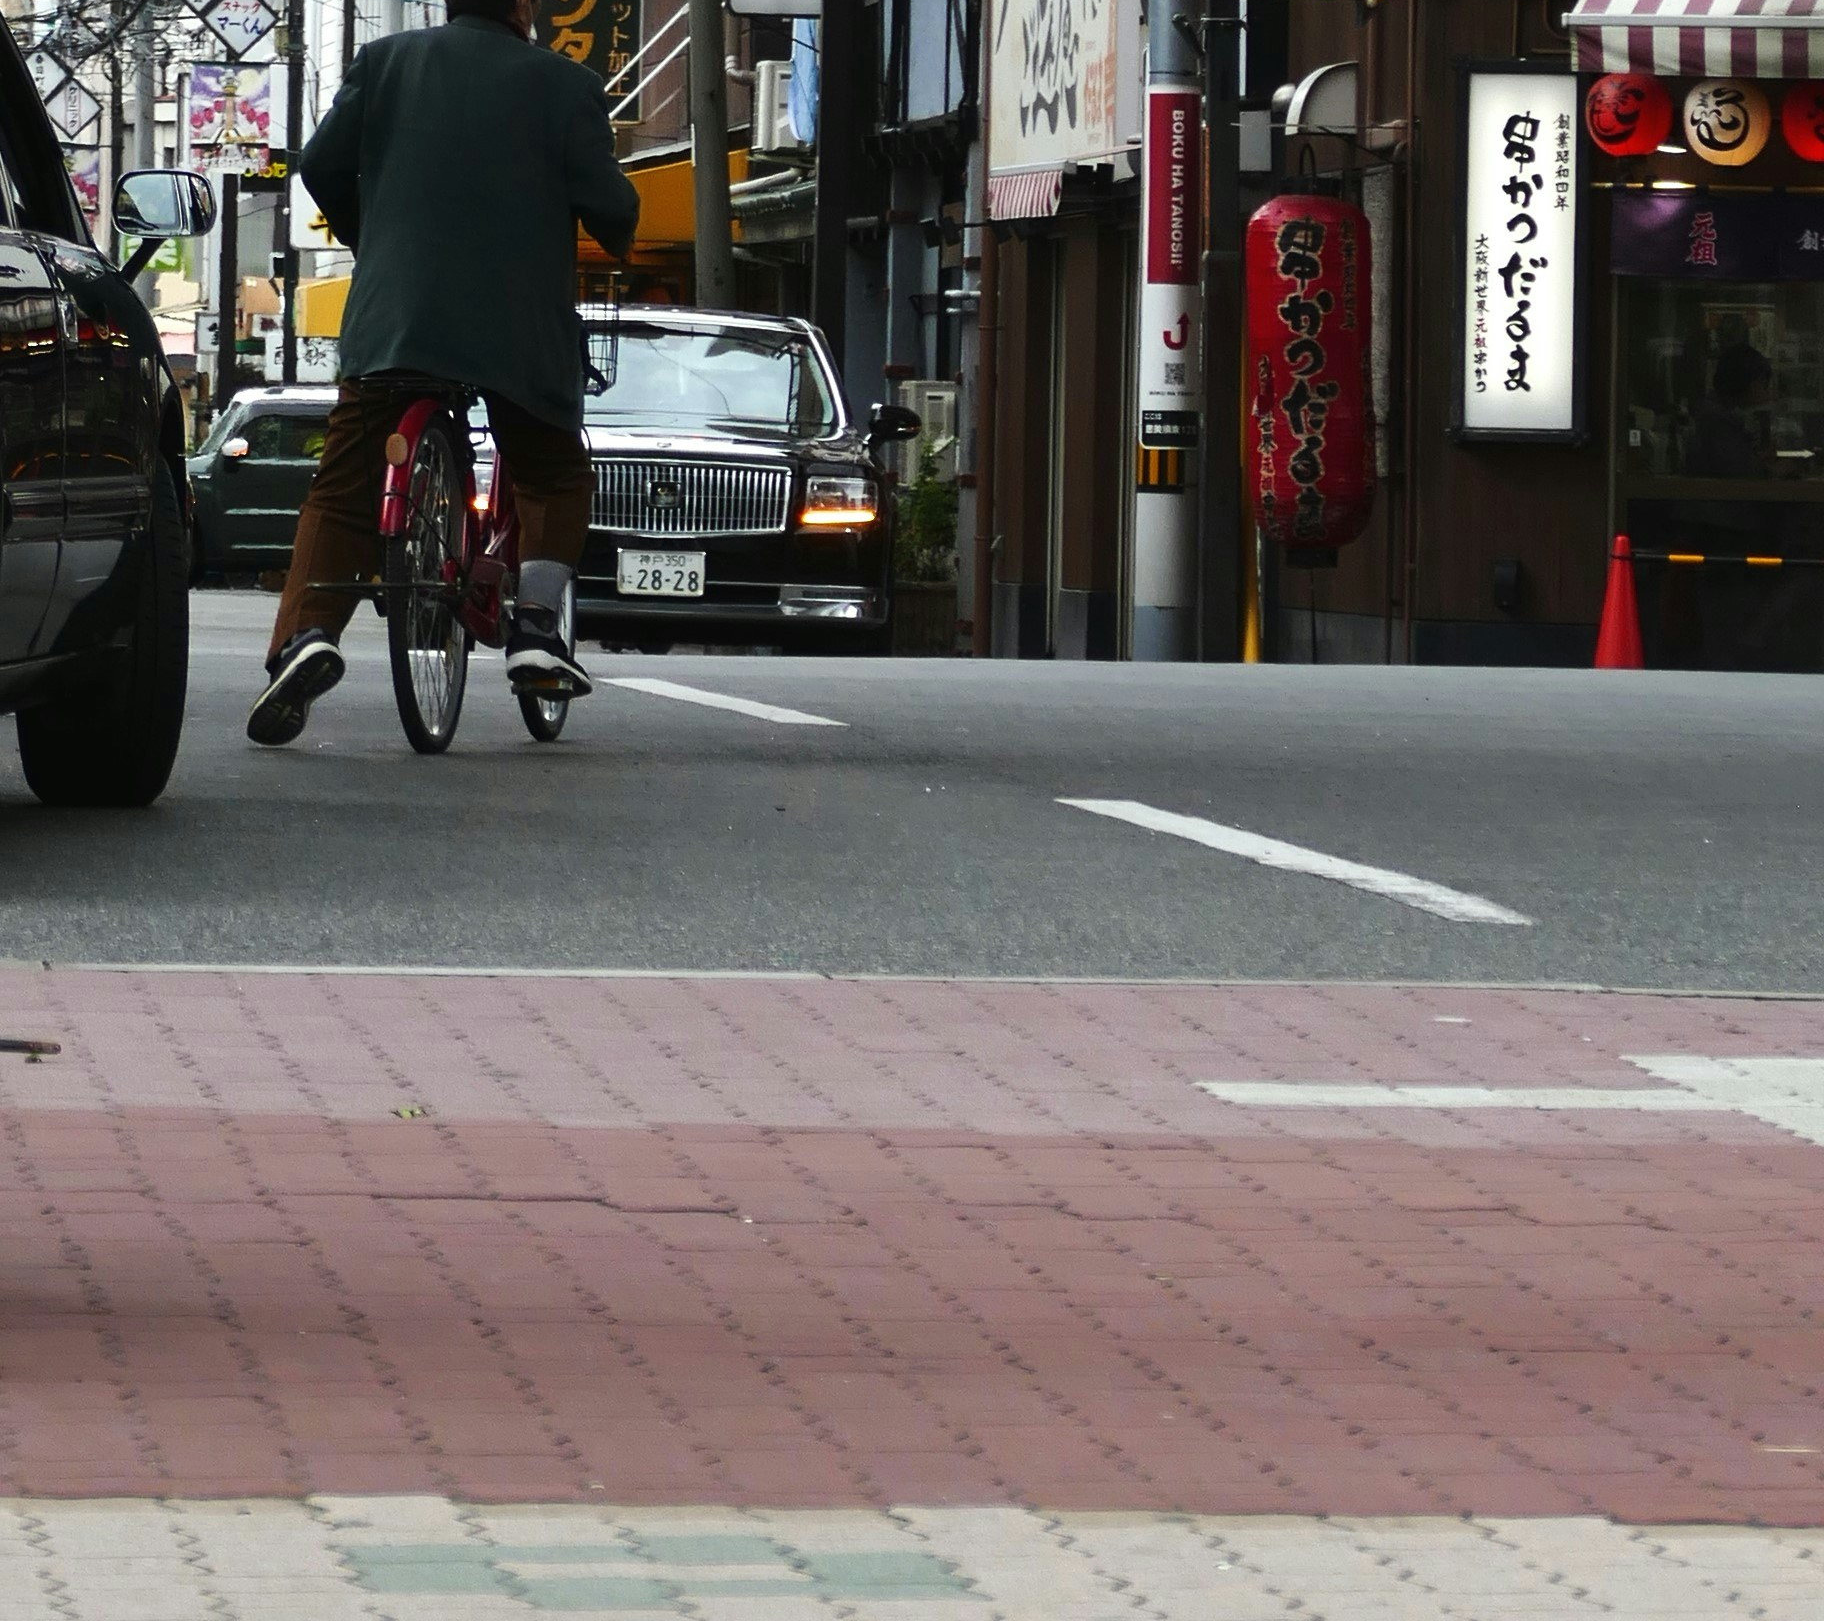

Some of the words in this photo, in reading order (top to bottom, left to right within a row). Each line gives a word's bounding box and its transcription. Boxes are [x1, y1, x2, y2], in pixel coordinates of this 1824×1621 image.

[223, 1, 261, 14] スナック
[217, 17, 264, 35] マーくん
[1171, 109, 1186, 159] BOKU
[1552, 112, 1571, 212] 創業昭和四年
[1171, 164, 1184, 188] HA
[1498, 110, 1549, 392] 串かつだるま
[1685, 212, 1718, 266] 元祖
[1797, 229, 1824, 251] 創
[636, 569, 699, 593] 28-28
